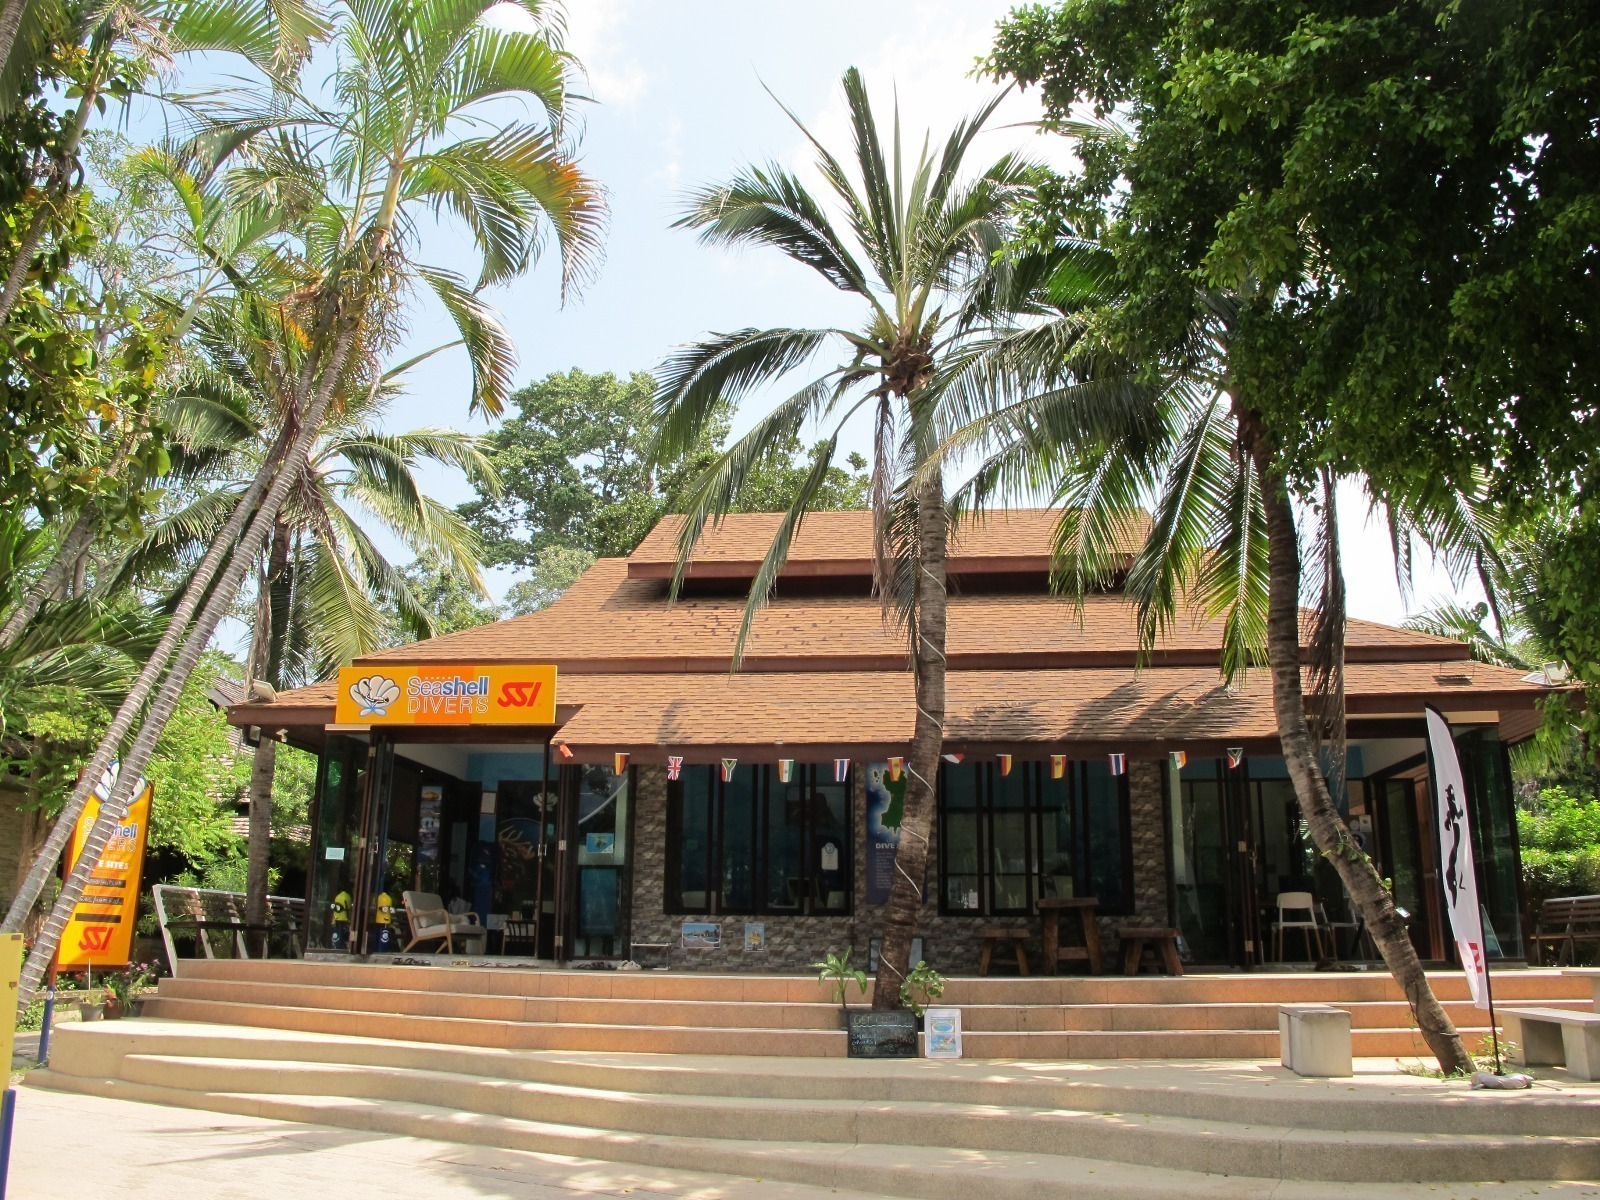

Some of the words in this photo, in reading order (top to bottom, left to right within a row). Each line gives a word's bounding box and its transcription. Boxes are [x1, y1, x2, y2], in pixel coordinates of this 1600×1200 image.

[406, 675, 490, 697] Seashell
[497, 681, 542, 707] SSI
[407, 696, 489, 714] DIVERS
[105, 861, 130, 870] SITES
[78, 926, 114, 951] SSI
